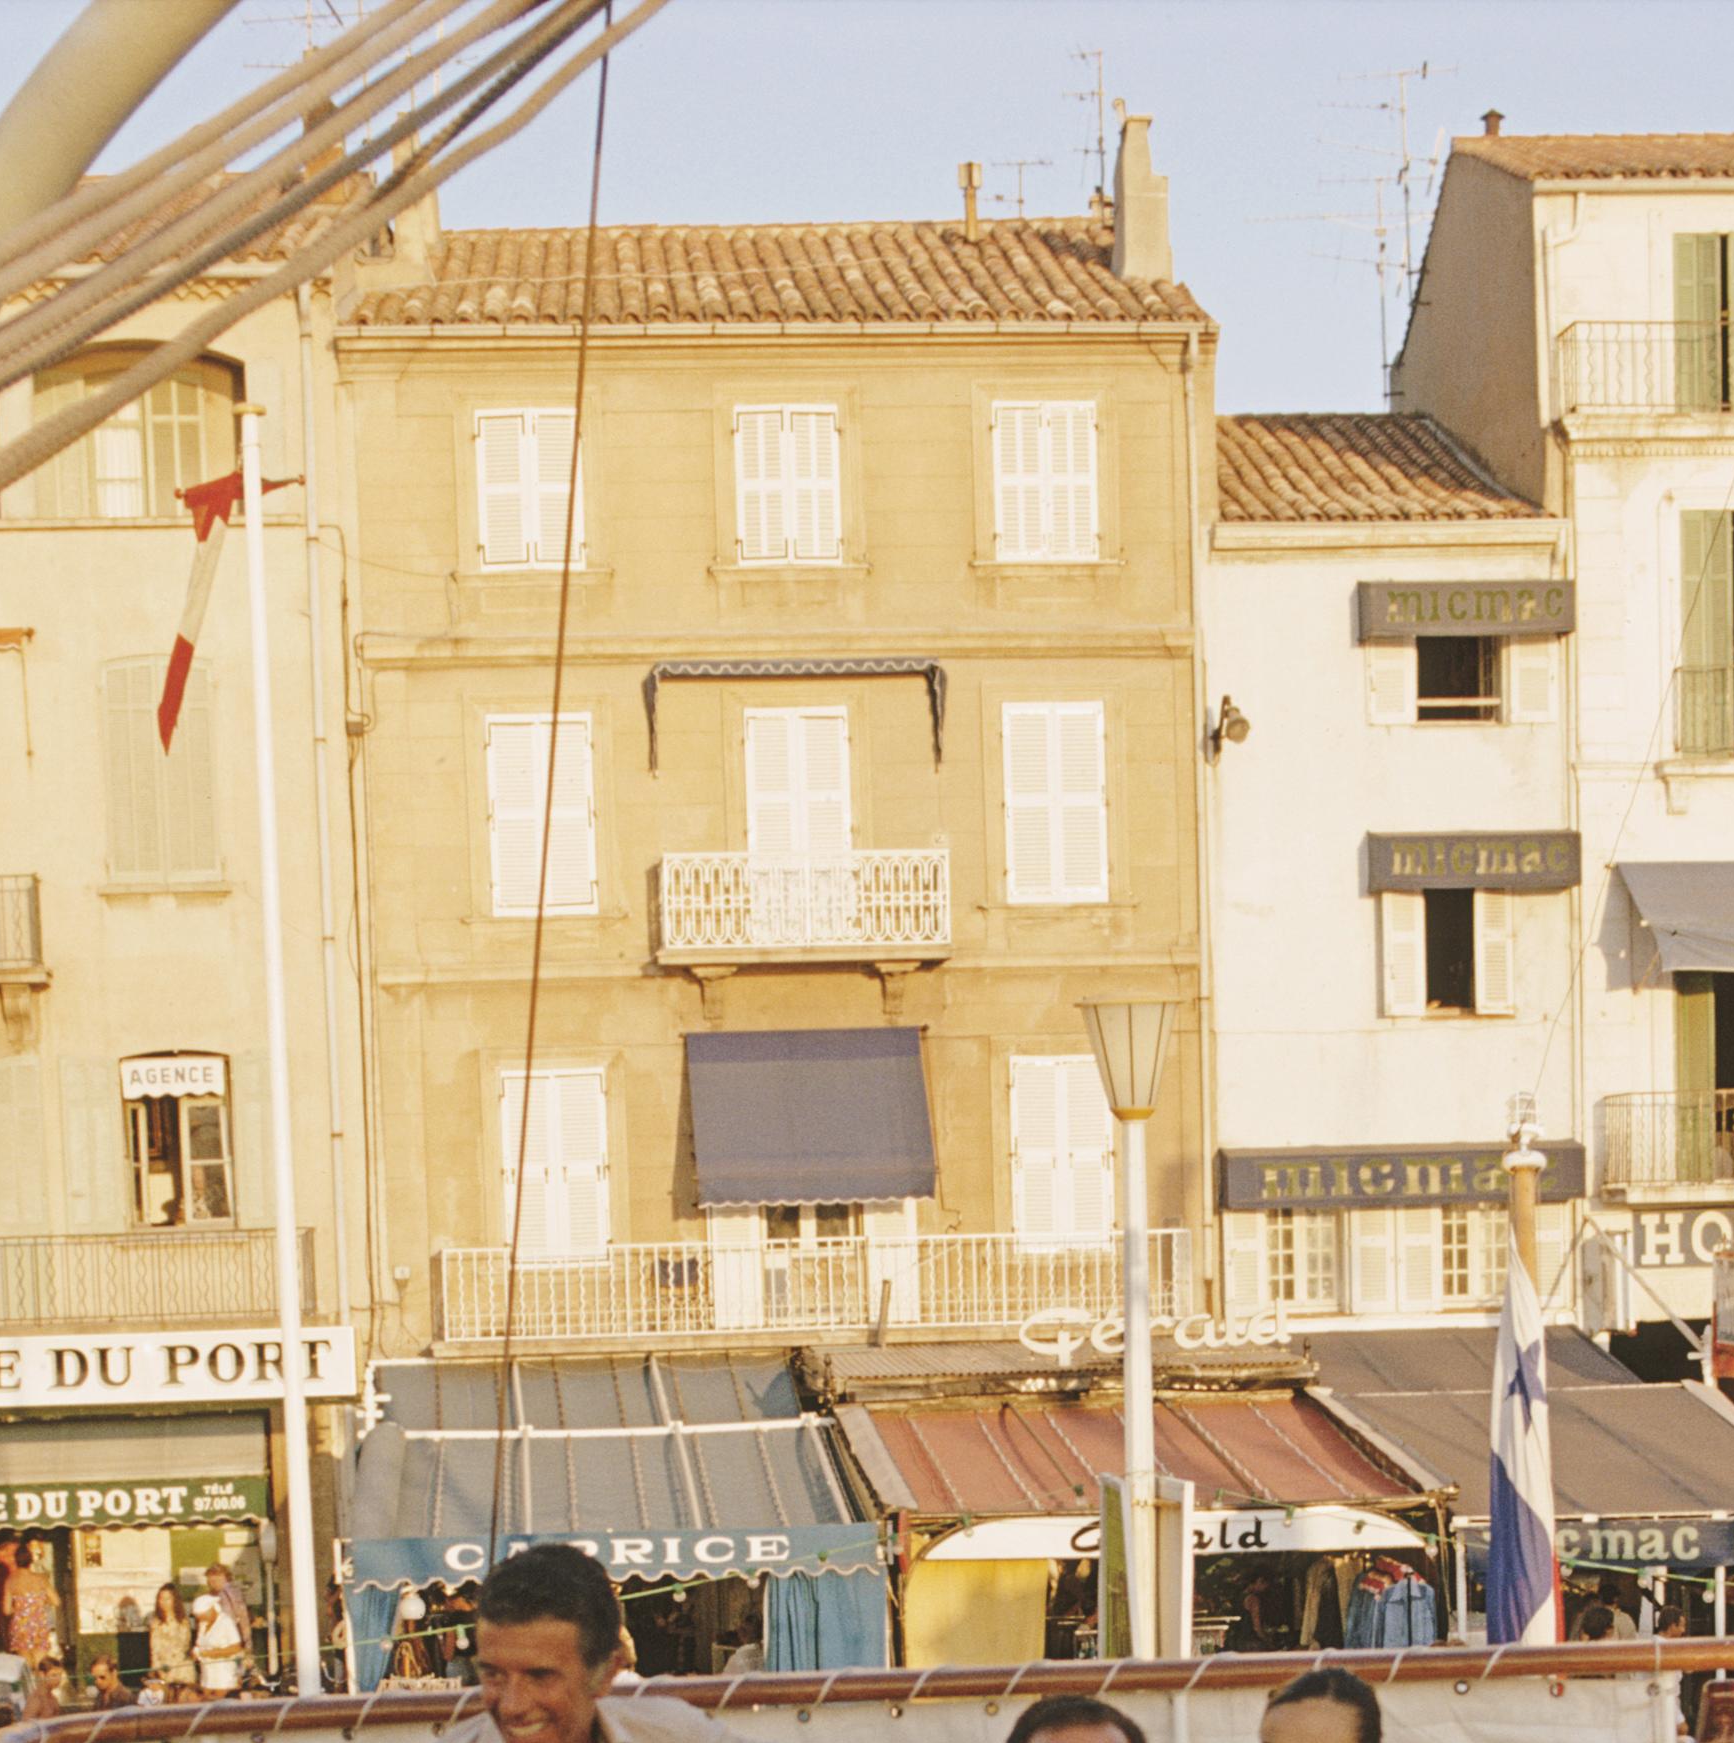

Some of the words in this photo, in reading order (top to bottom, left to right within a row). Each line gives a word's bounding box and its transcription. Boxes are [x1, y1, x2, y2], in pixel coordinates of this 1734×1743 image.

[129, 1063, 216, 1087] AGENCE
[48, 1345, 134, 1390] DU
[162, 1338, 333, 1386] PORT
[14, 1491, 68, 1521] DU
[77, 1485, 188, 1518] PORT
[444, 1535, 791, 1572] CRICE
